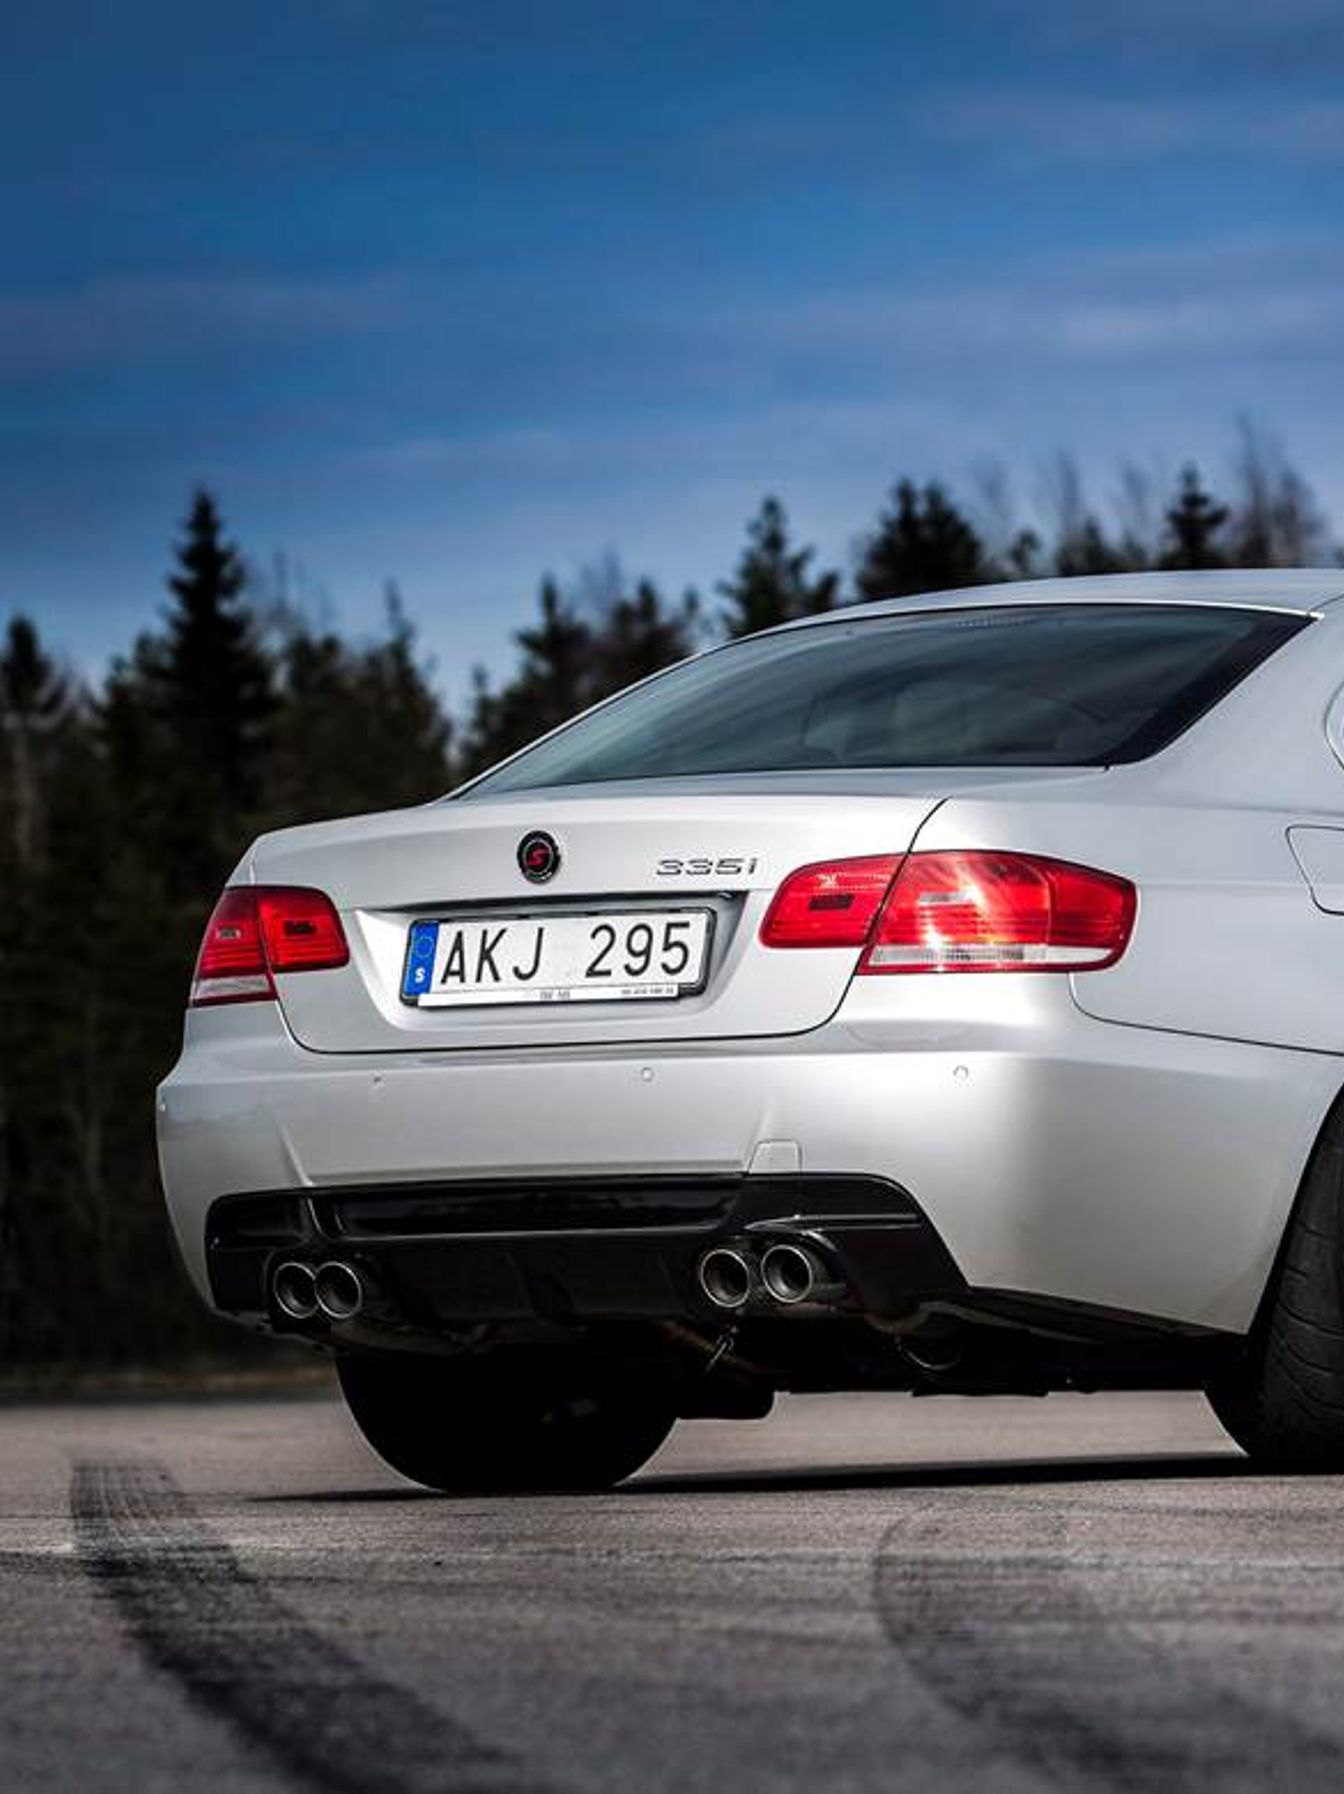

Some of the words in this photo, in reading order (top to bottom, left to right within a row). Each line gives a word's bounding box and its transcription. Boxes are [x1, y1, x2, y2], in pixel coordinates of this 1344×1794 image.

[656, 858, 756, 876] 335i
[440, 926, 544, 985] AKJ
[585, 920, 691, 979] 295
